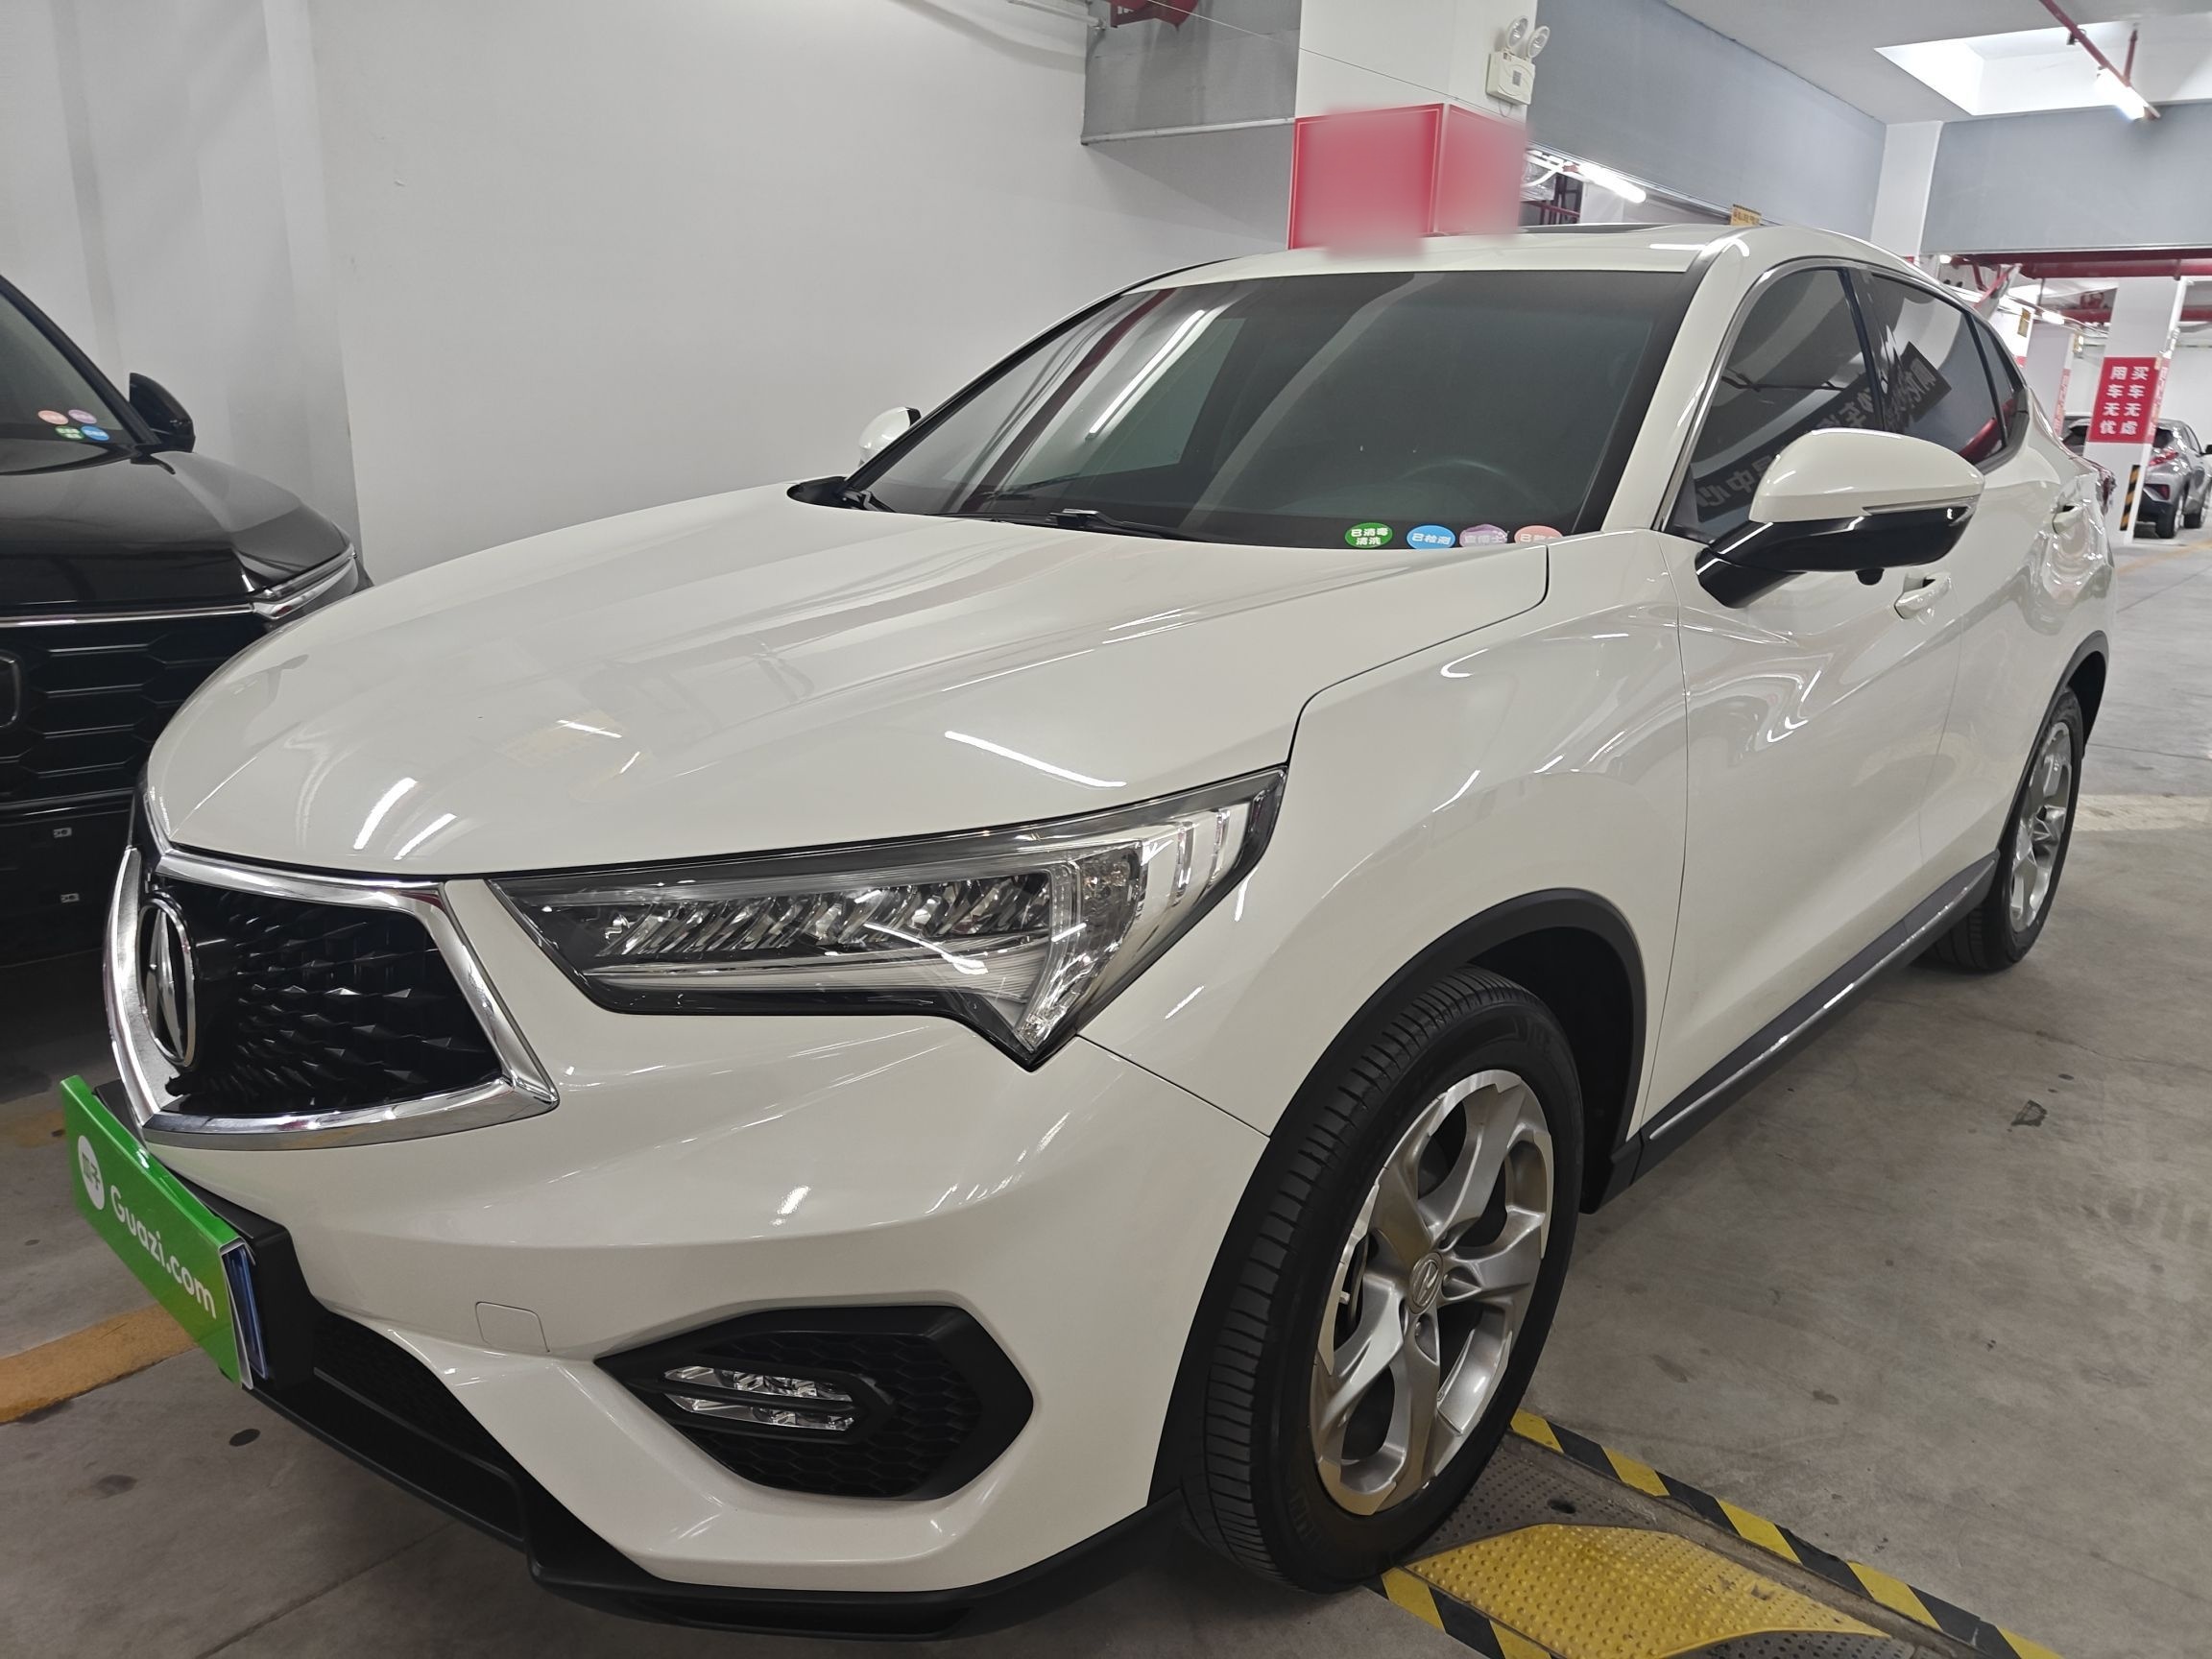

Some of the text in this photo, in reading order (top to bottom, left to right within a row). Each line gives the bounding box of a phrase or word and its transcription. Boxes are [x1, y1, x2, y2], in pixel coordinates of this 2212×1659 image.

[1411, 533, 1452, 545] 已检测
[110, 1185, 217, 1319] Guazi.com
